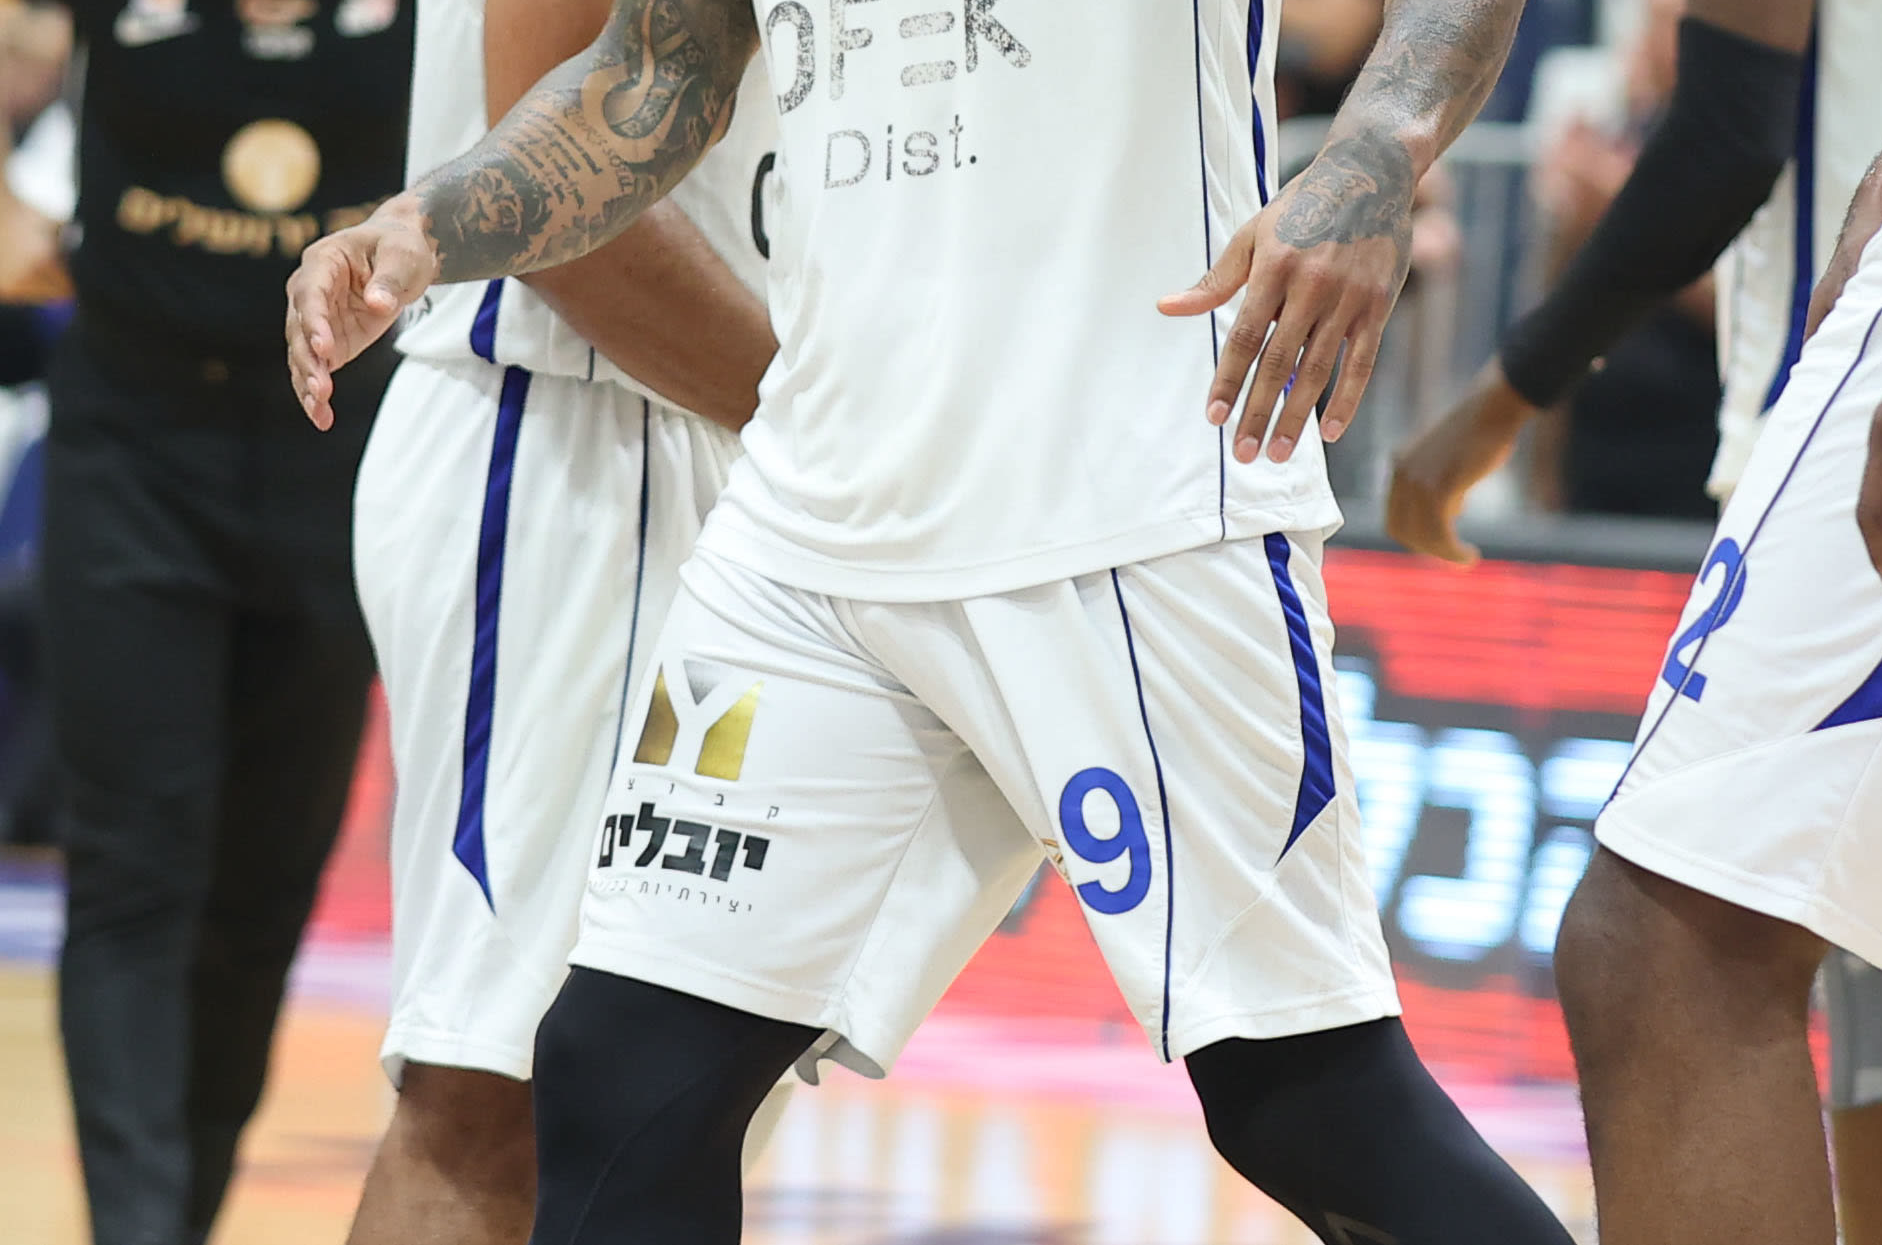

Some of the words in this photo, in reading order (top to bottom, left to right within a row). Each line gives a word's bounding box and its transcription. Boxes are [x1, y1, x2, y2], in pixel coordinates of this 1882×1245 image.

[823, 113, 978, 190] Dist.
[1661, 536, 1747, 703] 2
[626, 777, 780, 821] קבוצ
[1058, 766, 1153, 916] 9
